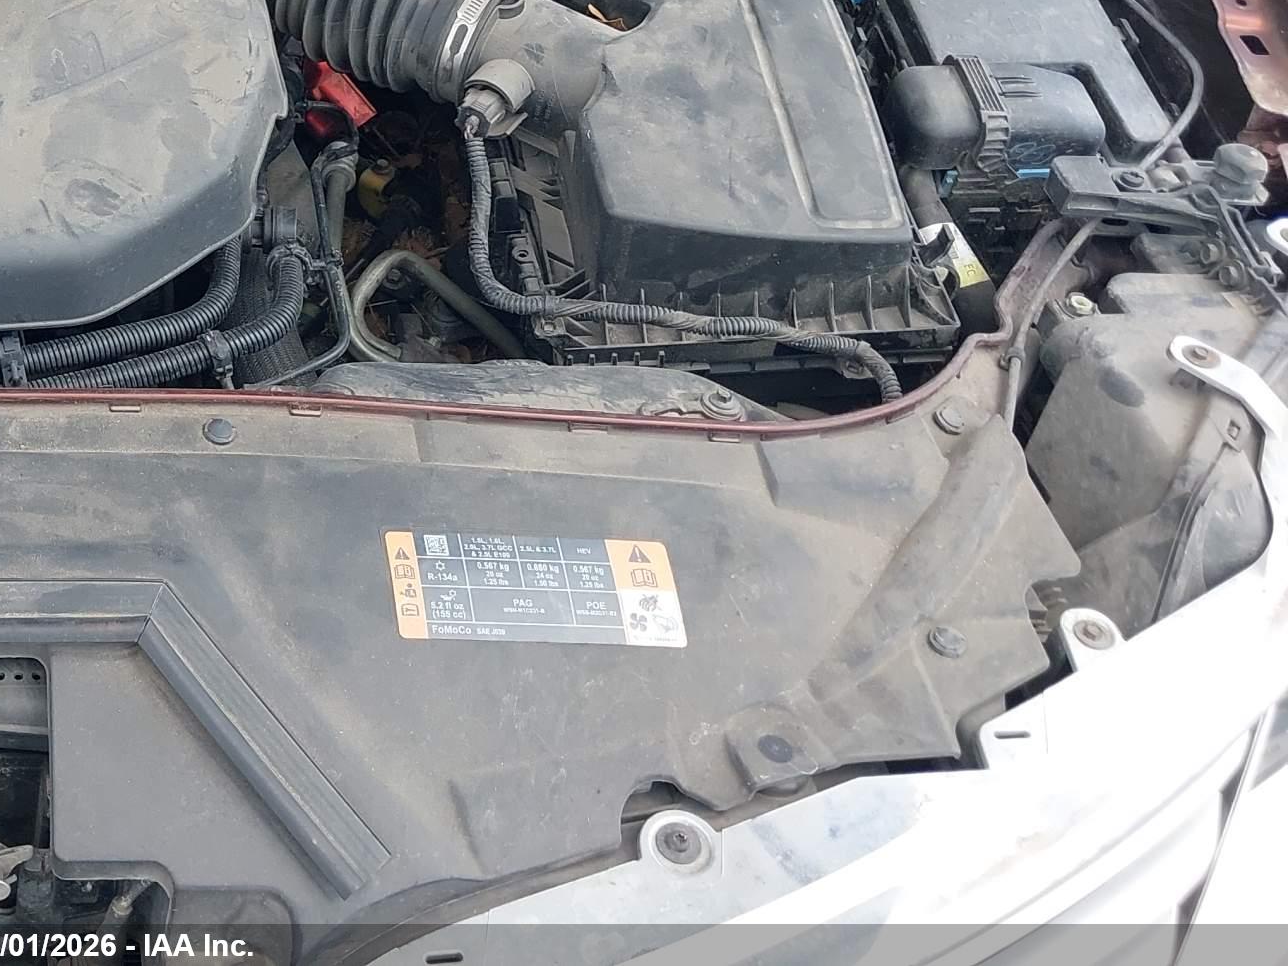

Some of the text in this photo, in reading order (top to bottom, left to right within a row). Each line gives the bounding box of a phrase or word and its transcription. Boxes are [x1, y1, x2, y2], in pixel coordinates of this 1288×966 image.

[576, 547, 592, 555] HEV
[499, 563, 510, 571] kg
[549, 564, 560, 573] kg
[594, 566, 604, 575] kg
[427, 572, 458, 581] R-134a
[430, 601, 444, 609] 5.2
[445, 601, 452, 609] fl
[512, 598, 533, 608] PAG
[586, 601, 607, 610] POE
[432, 608, 466, 620] (155 cc)
[431, 624, 472, 635] FoMoCo
[476, 627, 490, 635] SAE
